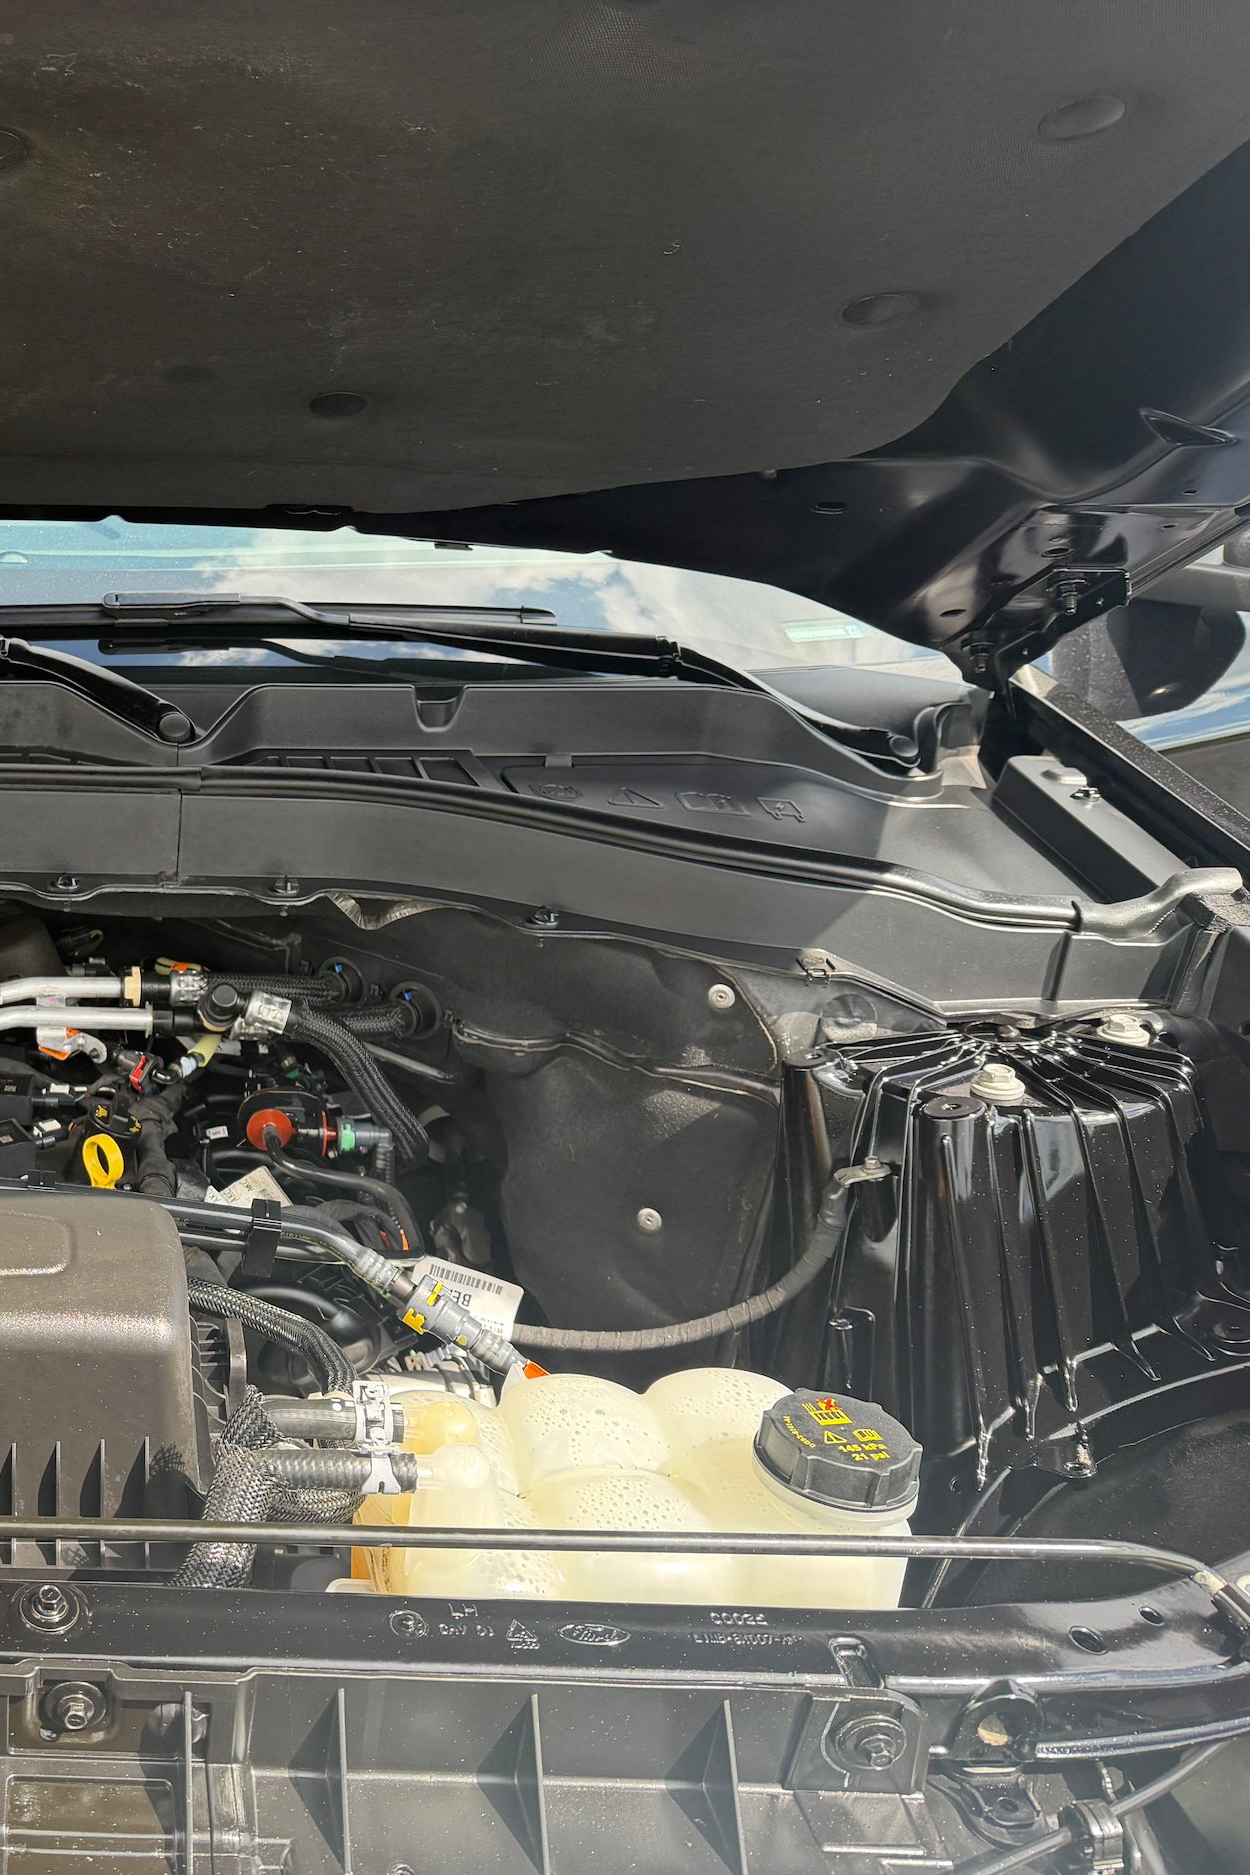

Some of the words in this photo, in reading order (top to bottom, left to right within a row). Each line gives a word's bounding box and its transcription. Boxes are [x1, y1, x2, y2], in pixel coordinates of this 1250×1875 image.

[838, 1443, 862, 1453] 145
[852, 1452, 869, 1461] 21
[448, 1603, 479, 1619] LH
